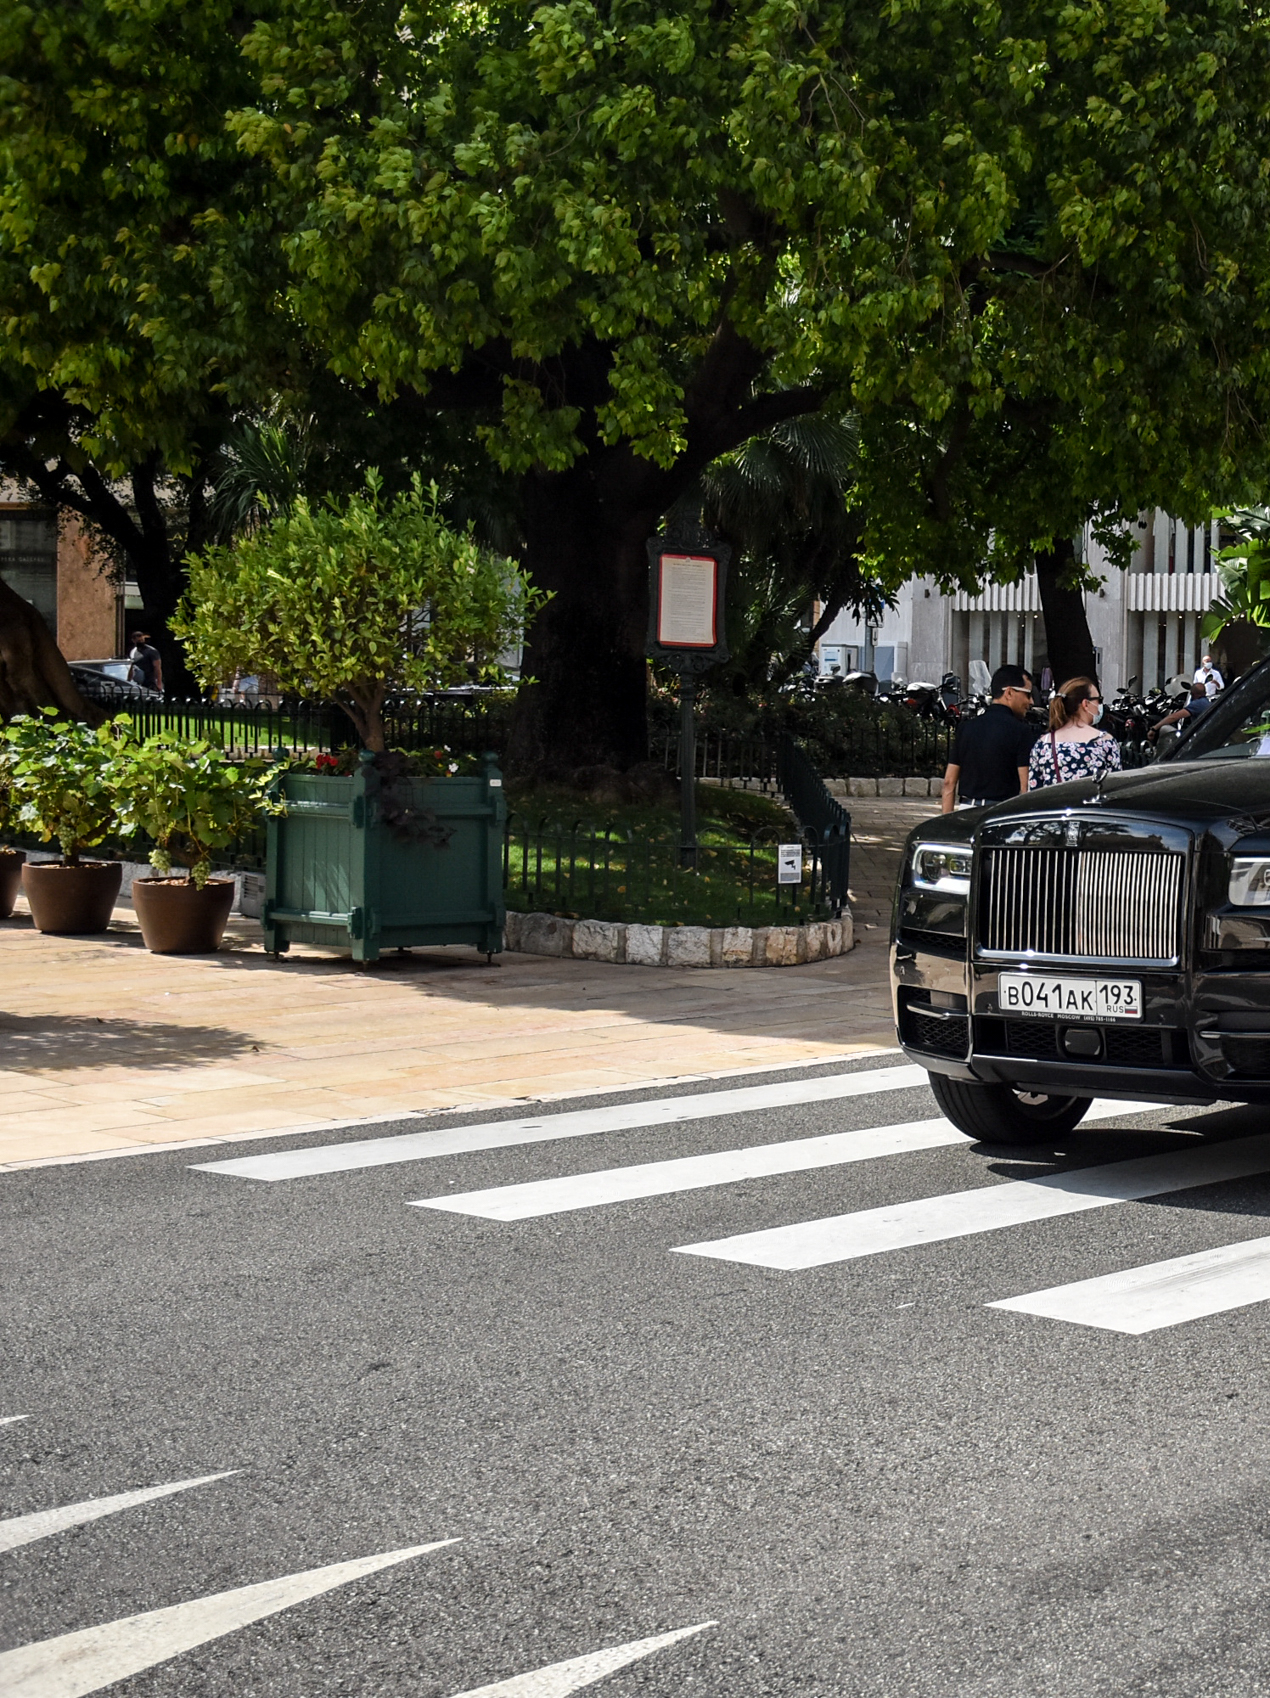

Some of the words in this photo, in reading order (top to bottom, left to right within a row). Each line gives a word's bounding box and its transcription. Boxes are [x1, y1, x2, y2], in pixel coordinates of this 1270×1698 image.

[1099, 984, 1134, 1006] 193
[1106, 1005, 1124, 1014] RUS
[1021, 1011, 1054, 1019] ROLLS-ROYCE
